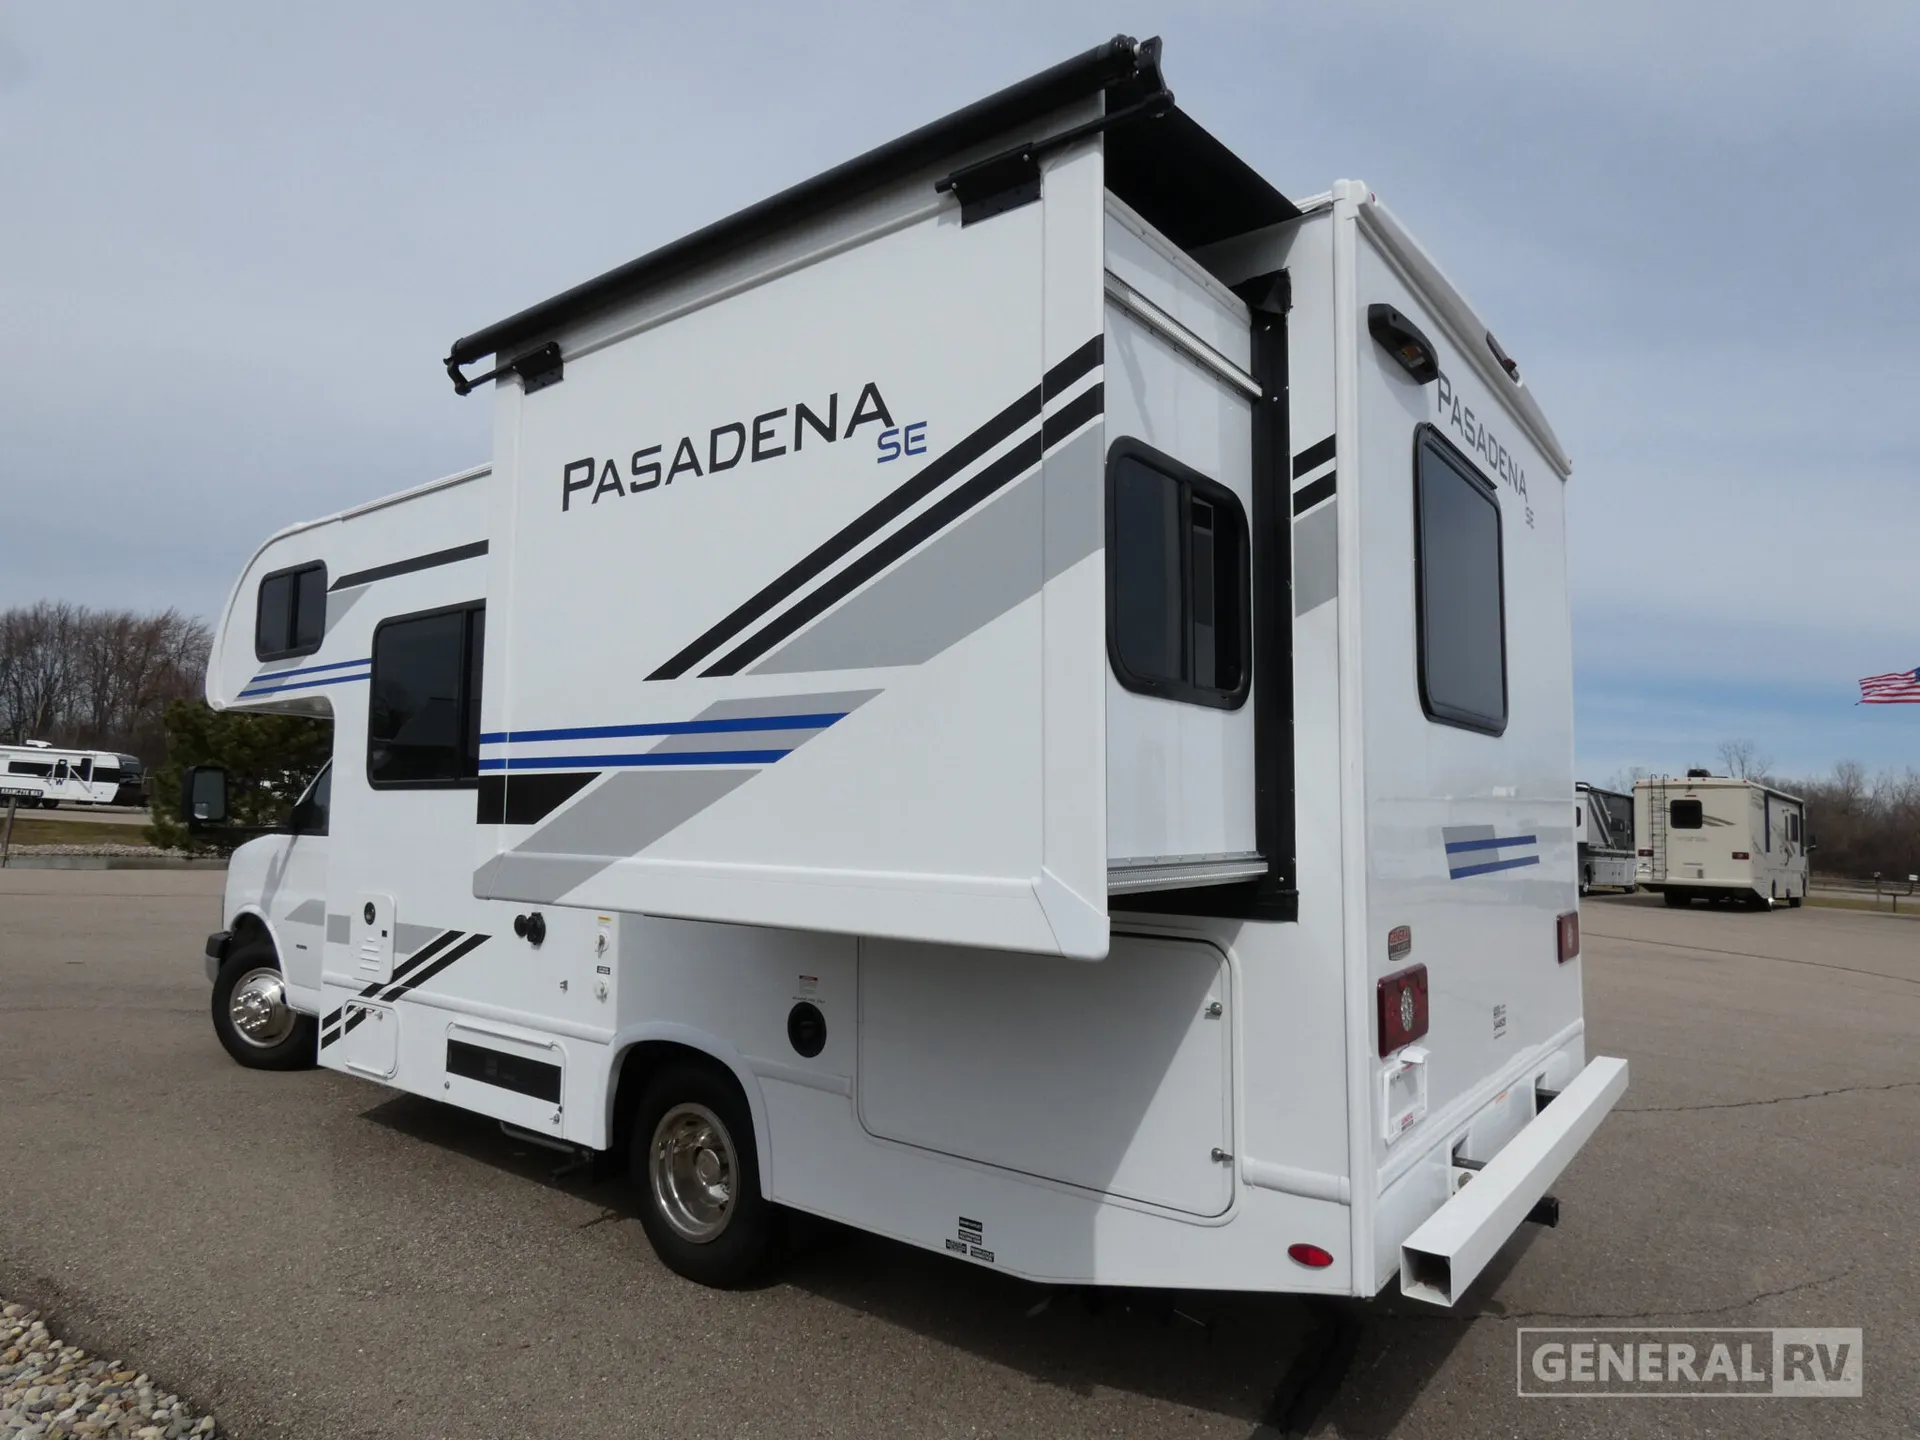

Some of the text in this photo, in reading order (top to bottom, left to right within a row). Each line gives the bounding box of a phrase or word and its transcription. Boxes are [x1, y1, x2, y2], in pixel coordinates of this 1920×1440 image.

[562, 381, 895, 512] PASADENA
[877, 421, 928, 464] SE
[1437, 370, 1528, 504] PASADENA
